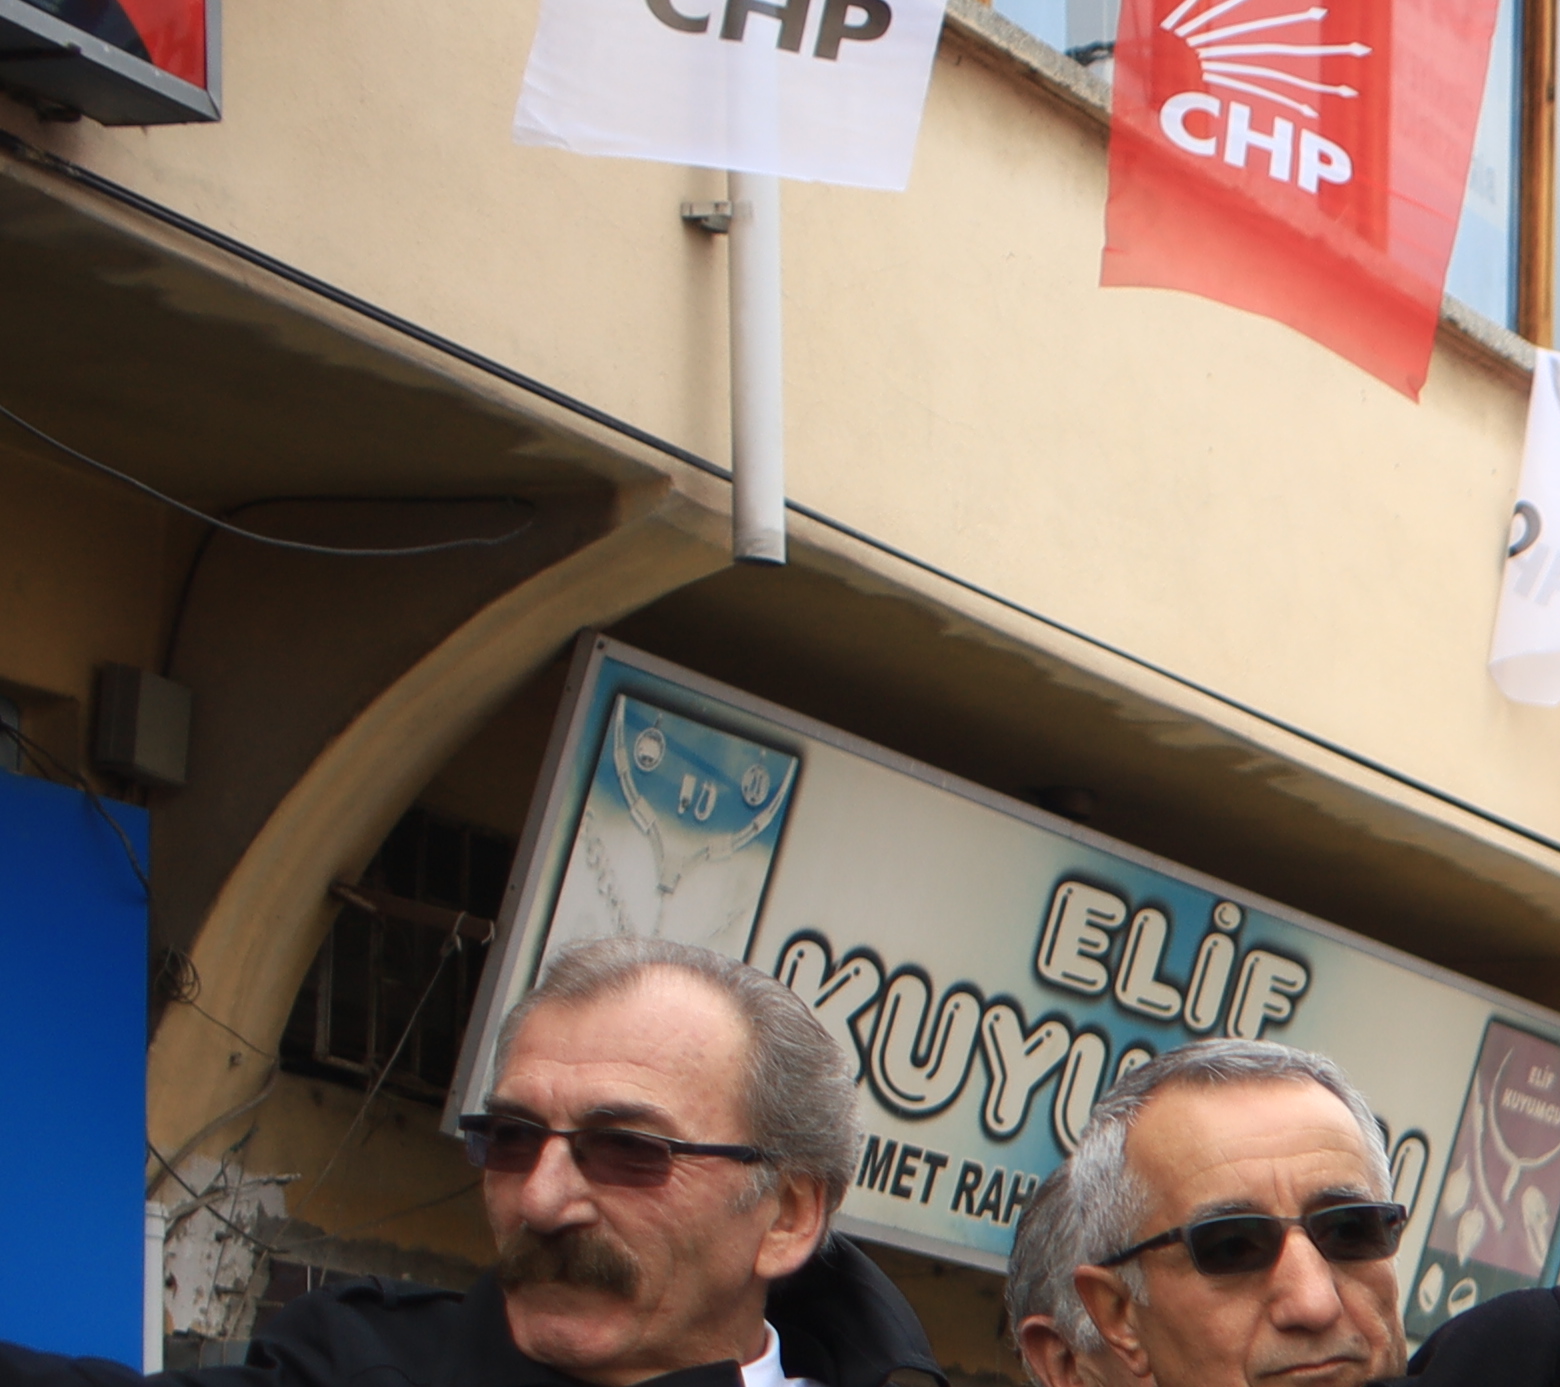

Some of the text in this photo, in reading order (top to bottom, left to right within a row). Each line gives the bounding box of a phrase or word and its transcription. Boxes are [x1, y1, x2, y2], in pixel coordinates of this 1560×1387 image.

[1159, 92, 1352, 194] CHP
[1038, 878, 1310, 1045] ELİF
[856, 1134, 1037, 1225] MET RAH
